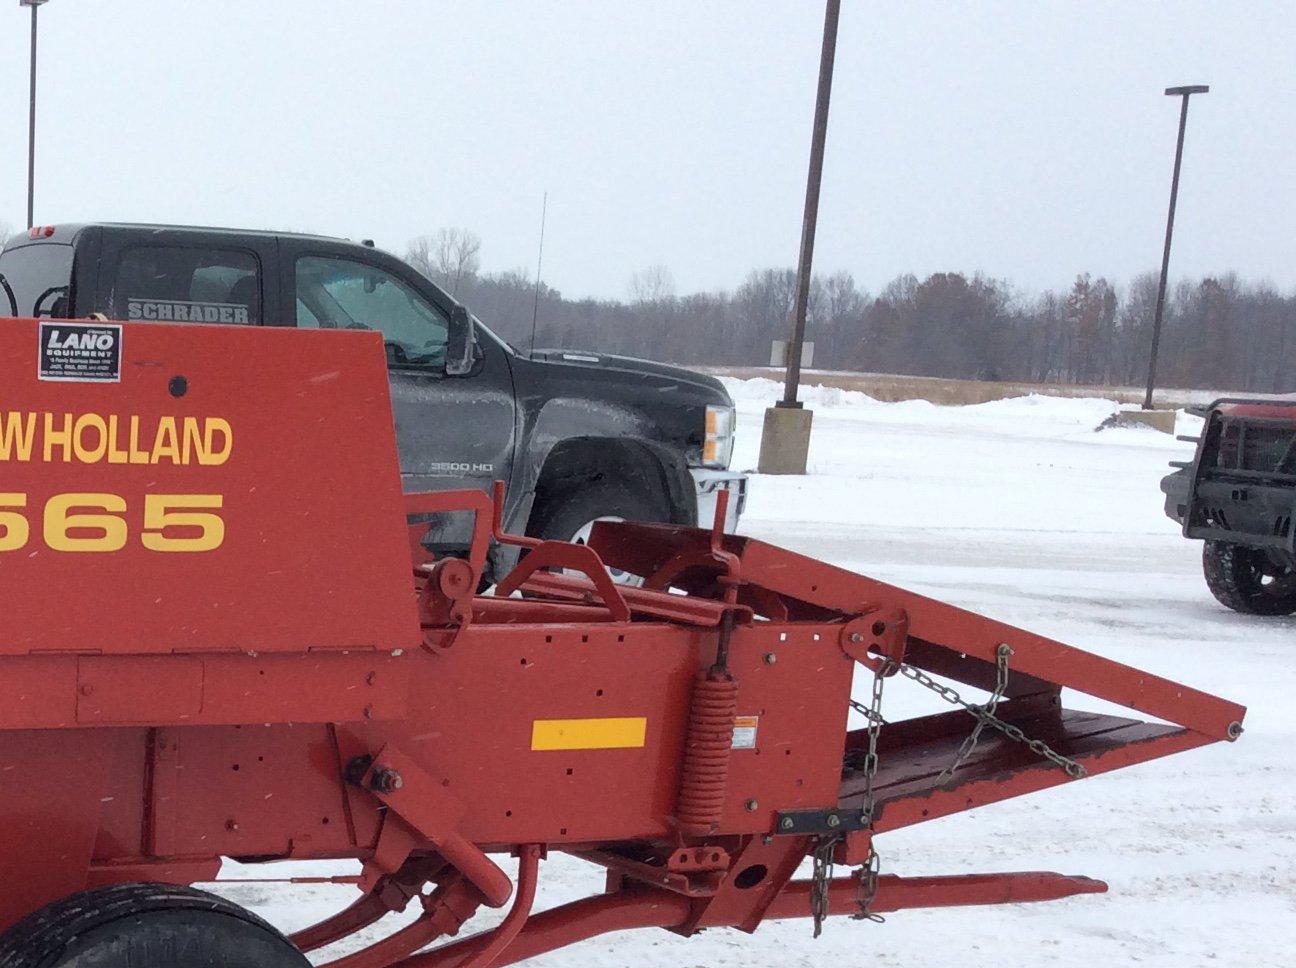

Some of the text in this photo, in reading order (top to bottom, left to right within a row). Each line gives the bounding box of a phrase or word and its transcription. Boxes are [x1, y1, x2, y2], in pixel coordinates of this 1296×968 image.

[127, 301, 249, 324] SCHRADER
[47, 330, 114, 350] LANO
[46, 349, 113, 358] EQUIPMENT
[43, 412, 233, 466] HOLLAND
